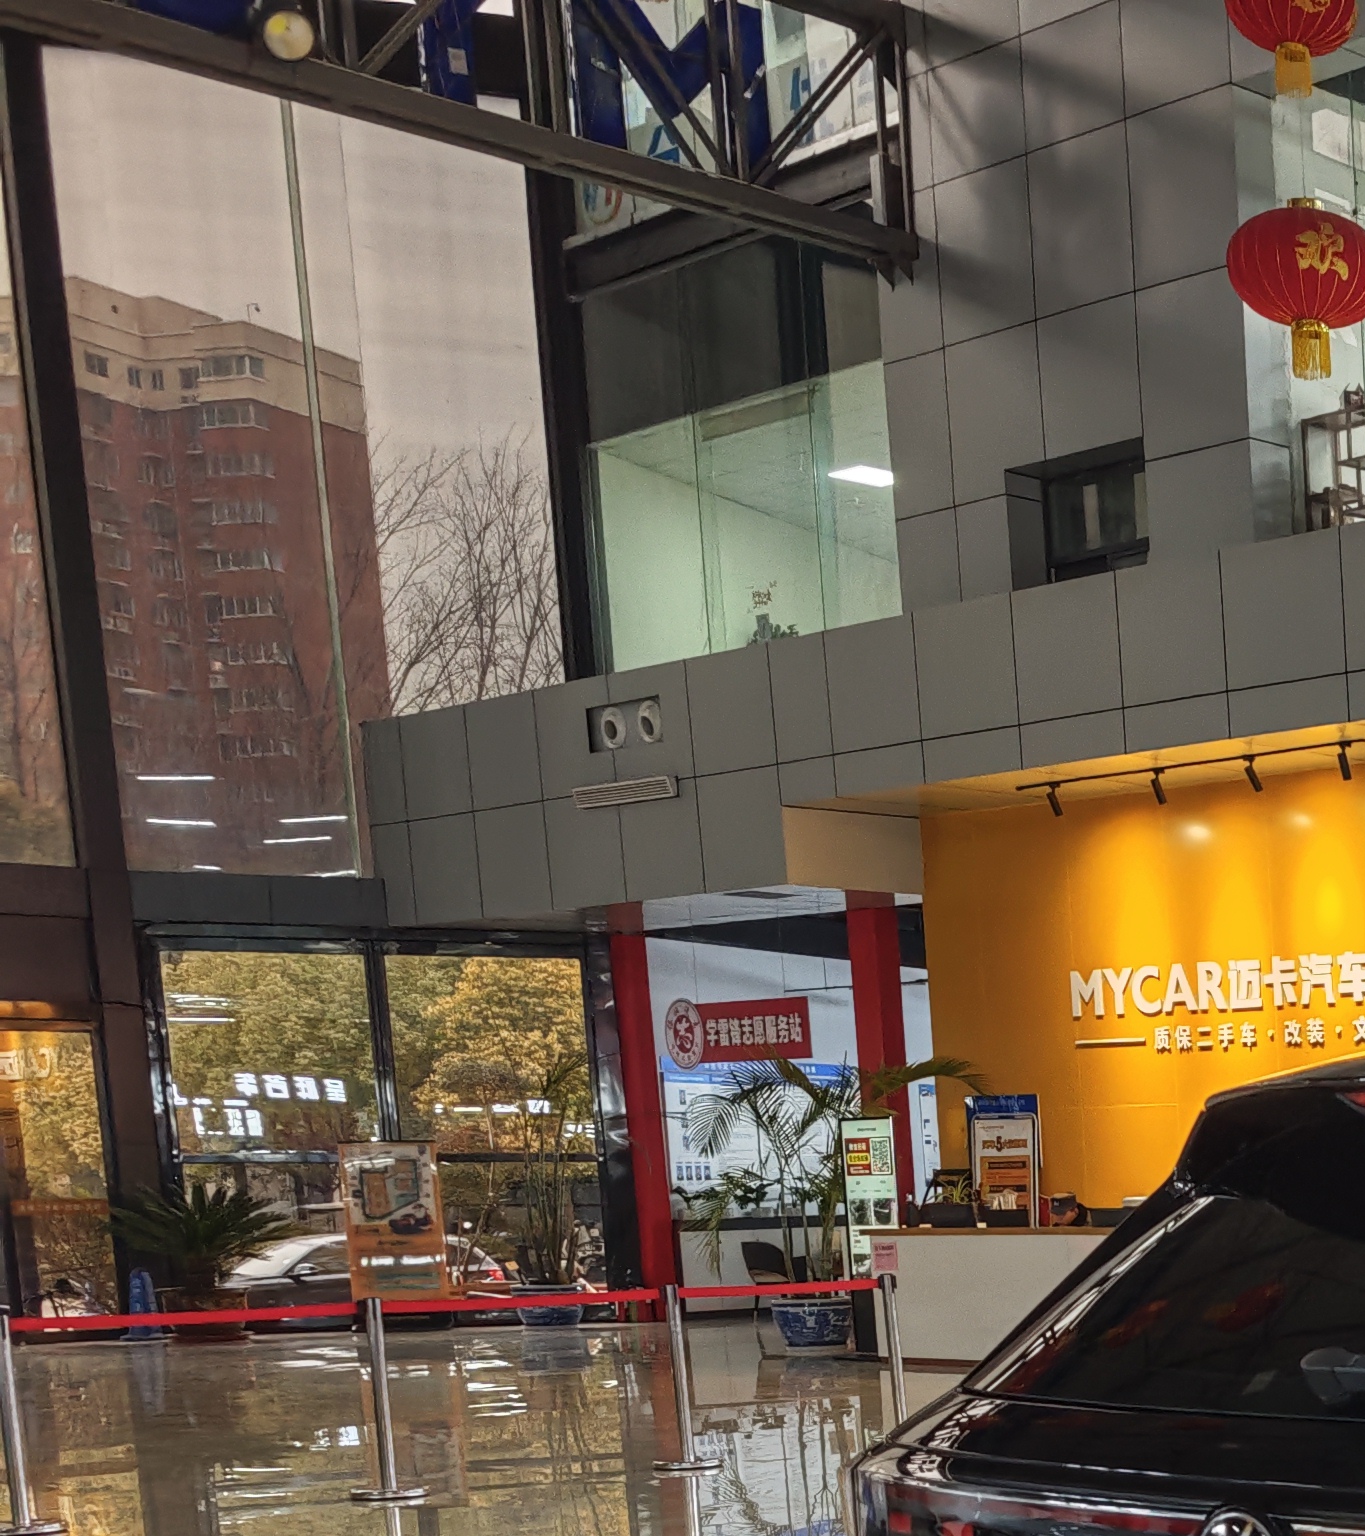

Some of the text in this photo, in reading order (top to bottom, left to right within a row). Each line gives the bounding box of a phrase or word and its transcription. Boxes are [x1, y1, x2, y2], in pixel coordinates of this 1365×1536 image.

[705, 1013, 803, 1047] 学雷锋志愿服务站
